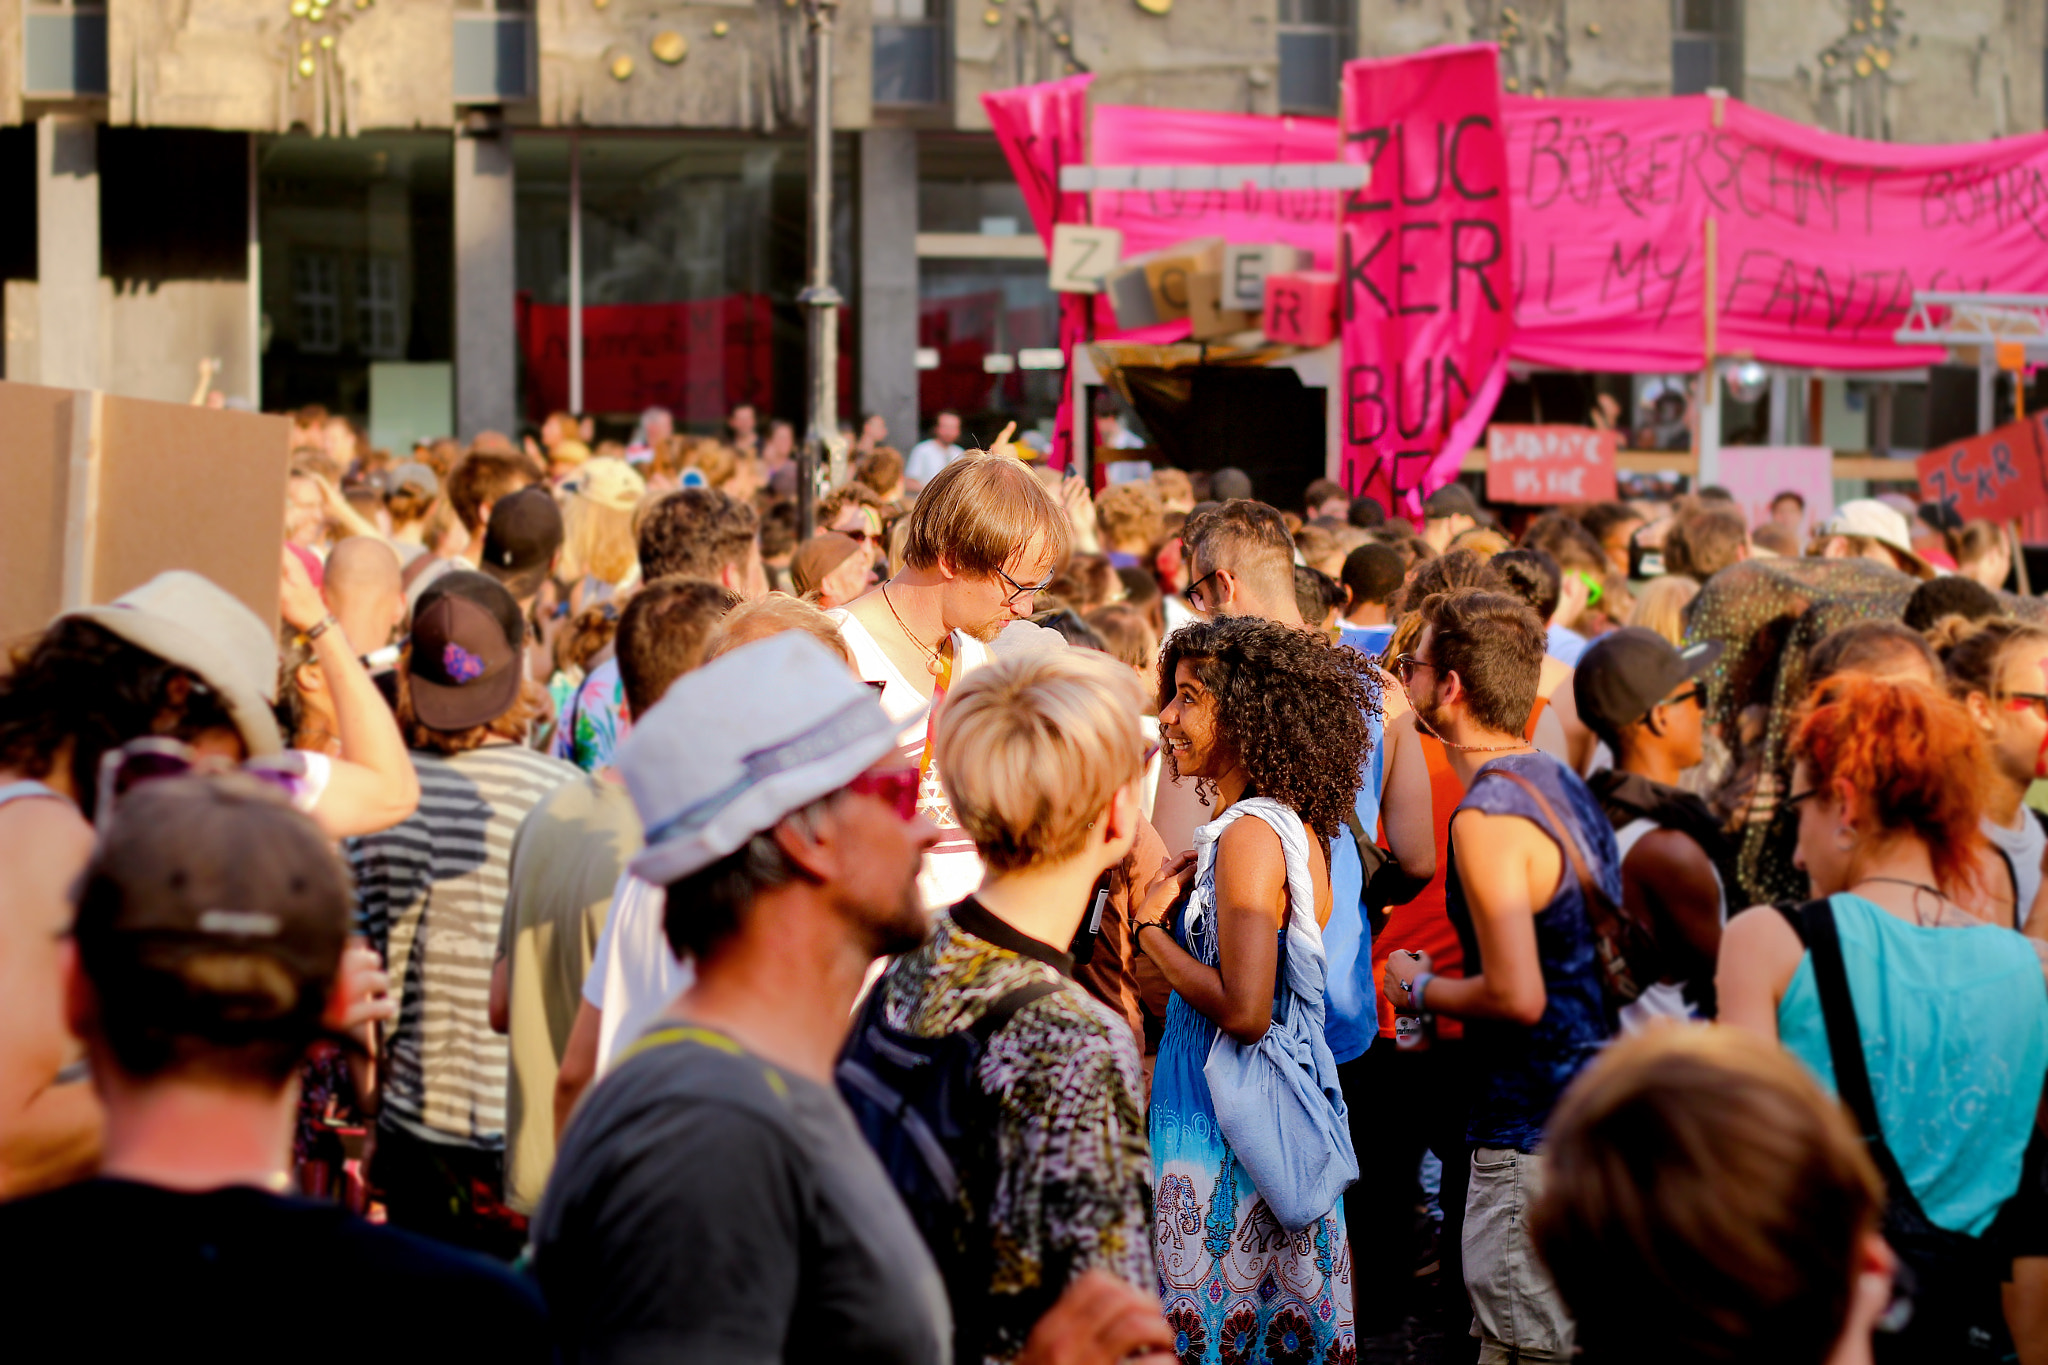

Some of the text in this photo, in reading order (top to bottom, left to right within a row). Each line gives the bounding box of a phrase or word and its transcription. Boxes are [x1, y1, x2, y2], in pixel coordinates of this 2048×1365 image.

[1345, 114, 1499, 213] ZUC
[1235, 254, 1262, 299] E
[1272, 289, 1301, 334] R
[1343, 219, 1502, 321] KER
[1600, 240, 1696, 332] MY
[1347, 356, 1474, 445] BUN
